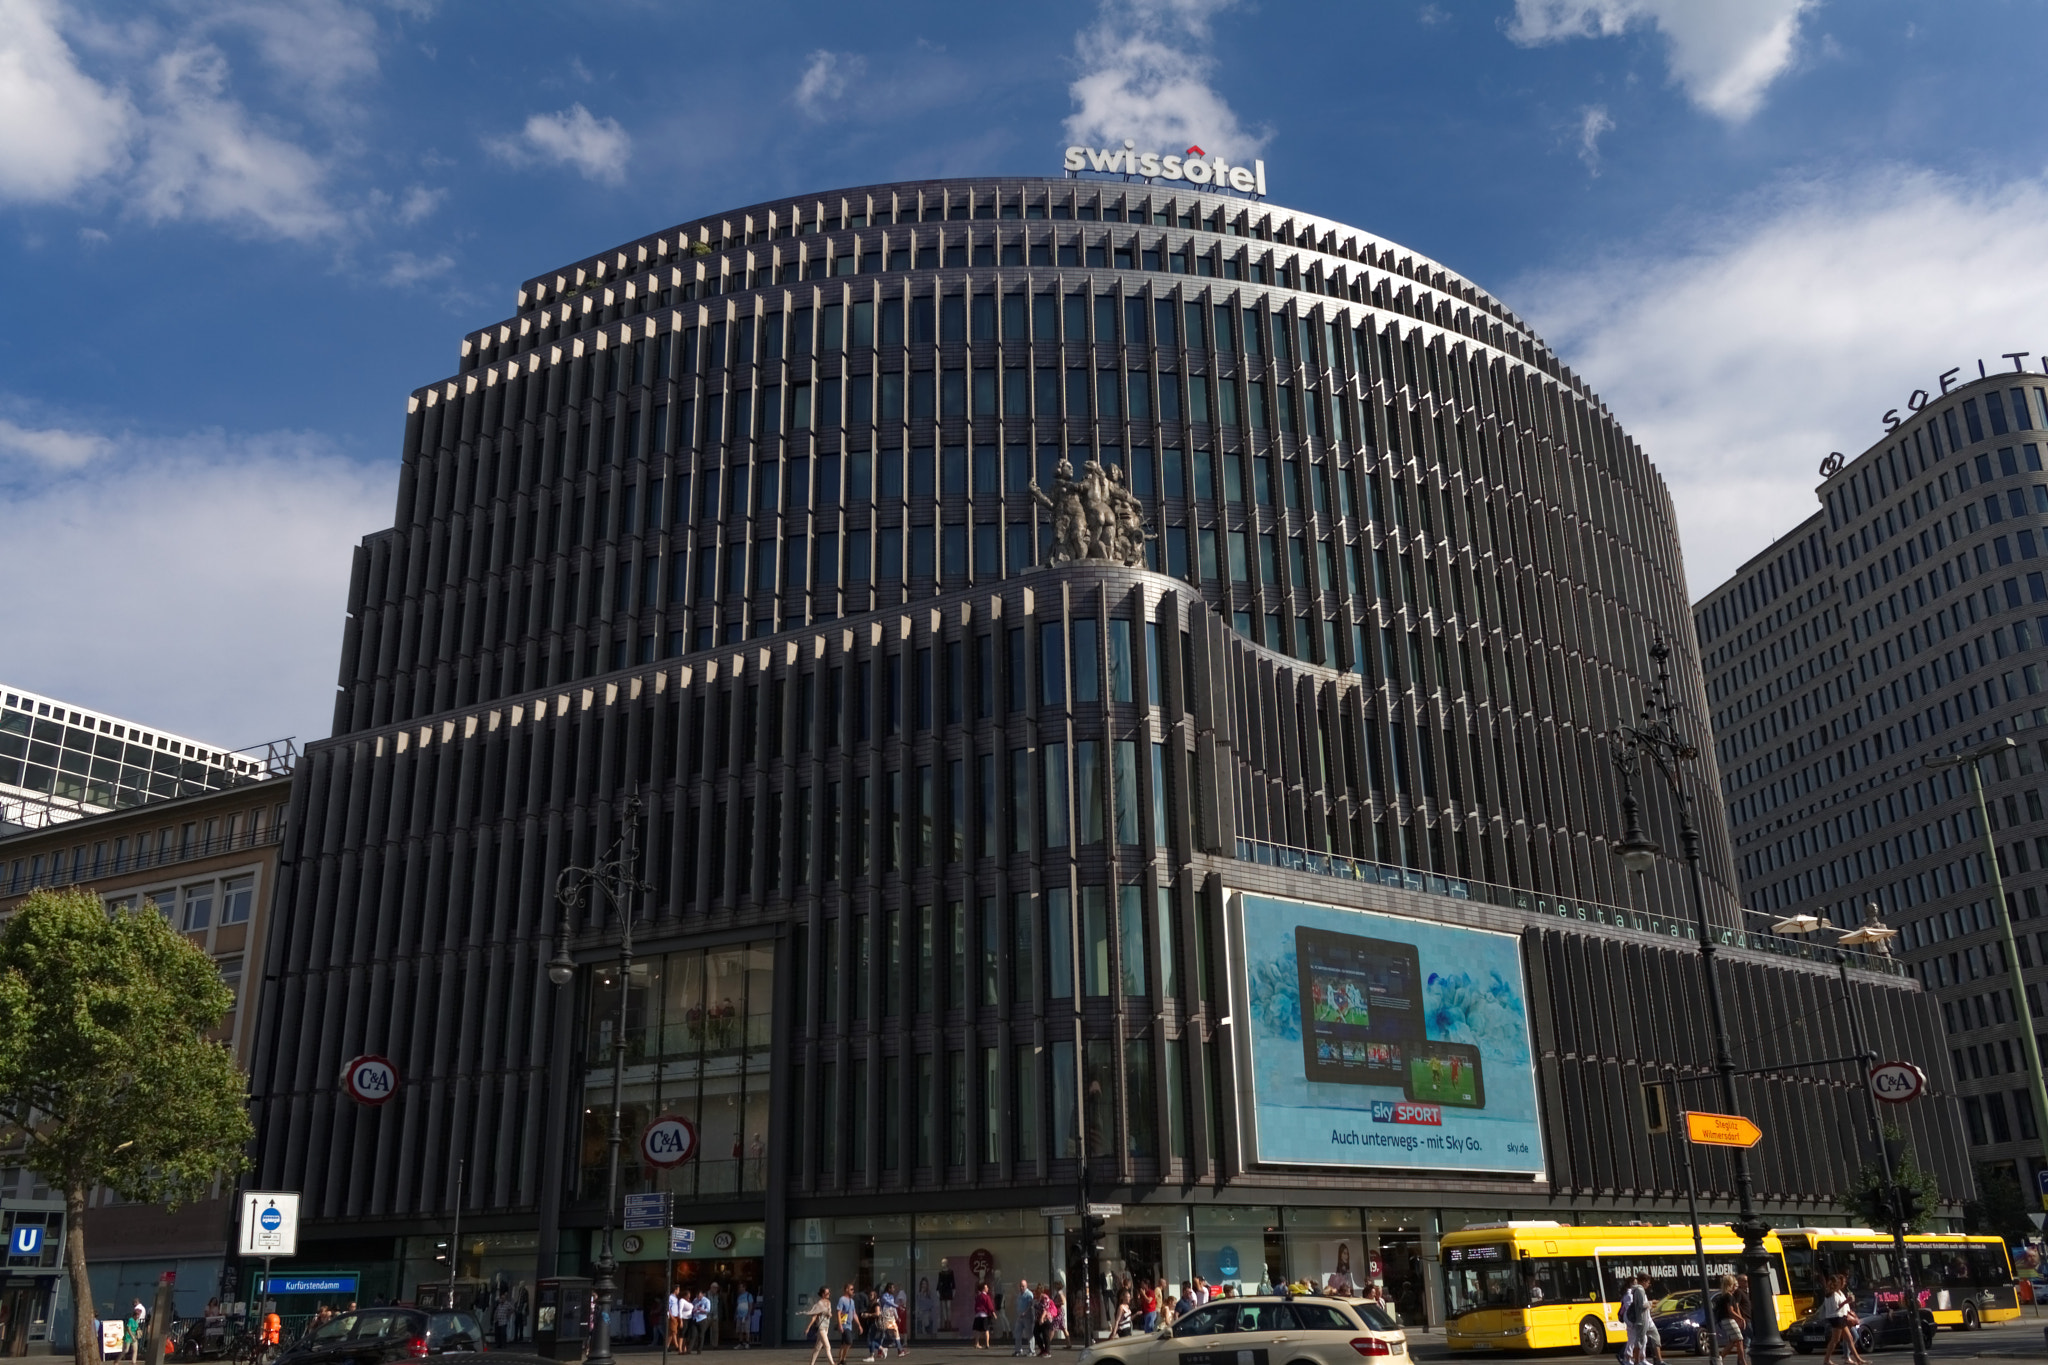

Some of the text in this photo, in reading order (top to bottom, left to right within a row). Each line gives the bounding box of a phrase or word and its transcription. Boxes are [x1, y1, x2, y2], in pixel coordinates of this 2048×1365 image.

[358, 1068, 389, 1092] C&A
[1876, 1072, 1912, 1092] C&A
[1373, 1102, 1439, 1122] sky SPORT
[1715, 1119, 1738, 1131] Steglitz
[650, 1128, 685, 1153] C&A
[1331, 1129, 1359, 1146] Auch
[1361, 1133, 1418, 1152] unterwegs
[1426, 1135, 1444, 1150] mit
[1446, 1135, 1464, 1153] Sky
[1465, 1136, 1483, 1151] Go.
[1702, 1130, 1740, 1141] Wilmersdorf
[1507, 1142, 1529, 1153] sky.de
[18, 1229, 37, 1252] U
[1650, 1265, 1678, 1278] WAGEN
[1681, 1264, 1700, 1277] VOLL
[1706, 1263, 1736, 1276] ELADEN.
[285, 1280, 340, 1291] Kurfürstendamm
